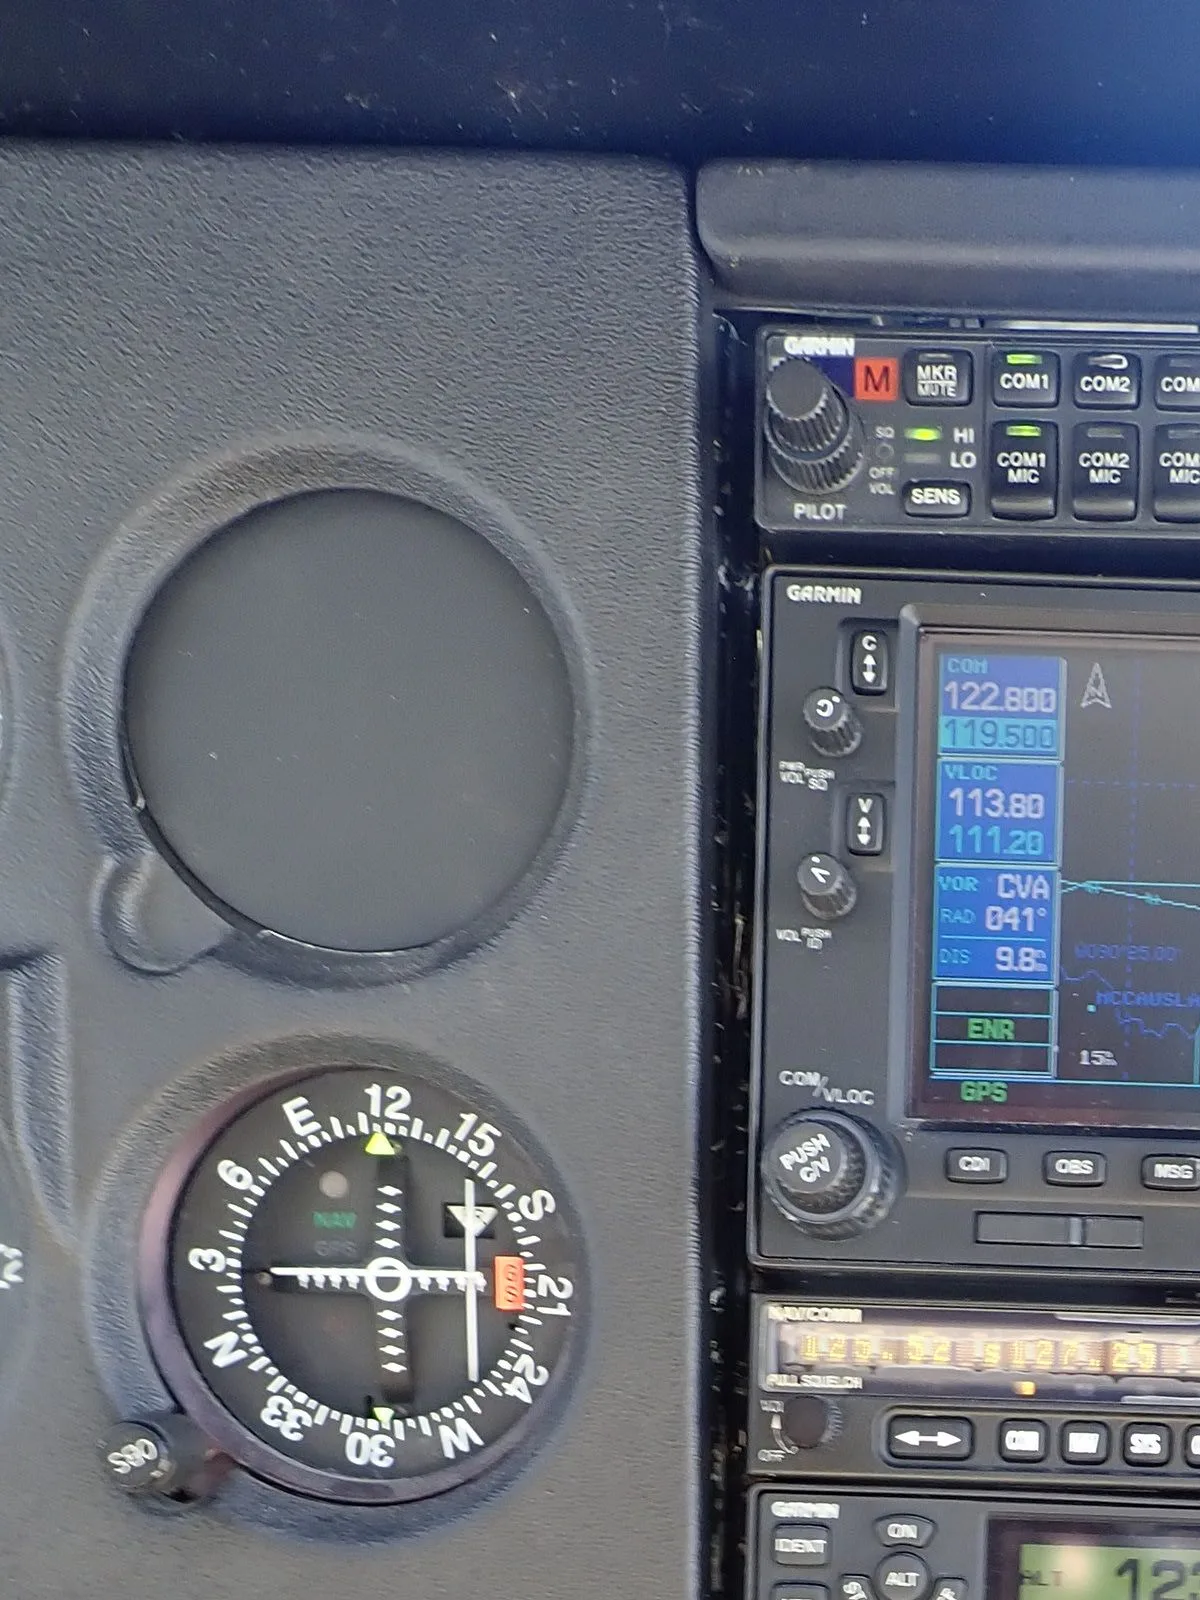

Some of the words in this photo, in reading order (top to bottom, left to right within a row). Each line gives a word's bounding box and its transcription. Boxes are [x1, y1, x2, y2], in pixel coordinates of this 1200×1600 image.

[863, 367, 890, 392] M
[917, 366, 957, 381] MKR
[917, 382, 956, 397] MUTE
[1000, 375, 1049, 389] COM1
[1080, 376, 1131, 392] COM2
[954, 428, 974, 442] HI
[950, 453, 976, 468] LO
[998, 452, 1045, 468] COM1
[1079, 453, 1129, 468] COM2
[868, 468, 894, 479] OFF
[1008, 468, 1039, 484] MIC
[1090, 468, 1120, 484] MIC
[1171, 468, 1200, 485] MIC
[868, 481, 895, 495] VOL
[911, 489, 960, 504] SENS
[793, 503, 845, 520] PILOT
[786, 585, 862, 604] GARMIN
[862, 635, 877, 651] C
[947, 658, 988, 673] COM
[944, 681, 1056, 712] 122.800
[944, 719, 1055, 748] 119.500
[946, 766, 998, 780] VLOC
[858, 798, 872, 813] V
[949, 788, 1044, 819] 113.80
[949, 826, 1044, 855] 111.20
[939, 876, 978, 891] VOR
[997, 874, 1049, 900] CVA
[941, 909, 975, 924] RAD
[968, 1018, 1015, 1040] ENR
[961, 1081, 1007, 1102] GPS
[364, 1083, 412, 1121] 12
[282, 1096, 321, 1138] E
[453, 1112, 502, 1159] 15
[779, 1133, 831, 1171] PUSH
[959, 1157, 990, 1172] CDI
[1055, 1159, 1093, 1174] OBS
[1154, 1164, 1193, 1180] MSG
[217, 1159, 253, 1191] 6
[518, 1189, 556, 1221] S
[188, 1248, 226, 1273] 3
[536, 1276, 574, 1317] 21
[204, 1332, 248, 1368] N
[501, 1354, 549, 1404] 24
[260, 1395, 313, 1441] 33
[438, 1417, 484, 1459] W
[346, 1432, 396, 1468] 30
[887, 1523, 917, 1538] ON
[775, 1539, 826, 1554] IDENT
[885, 1572, 919, 1587] ALT
